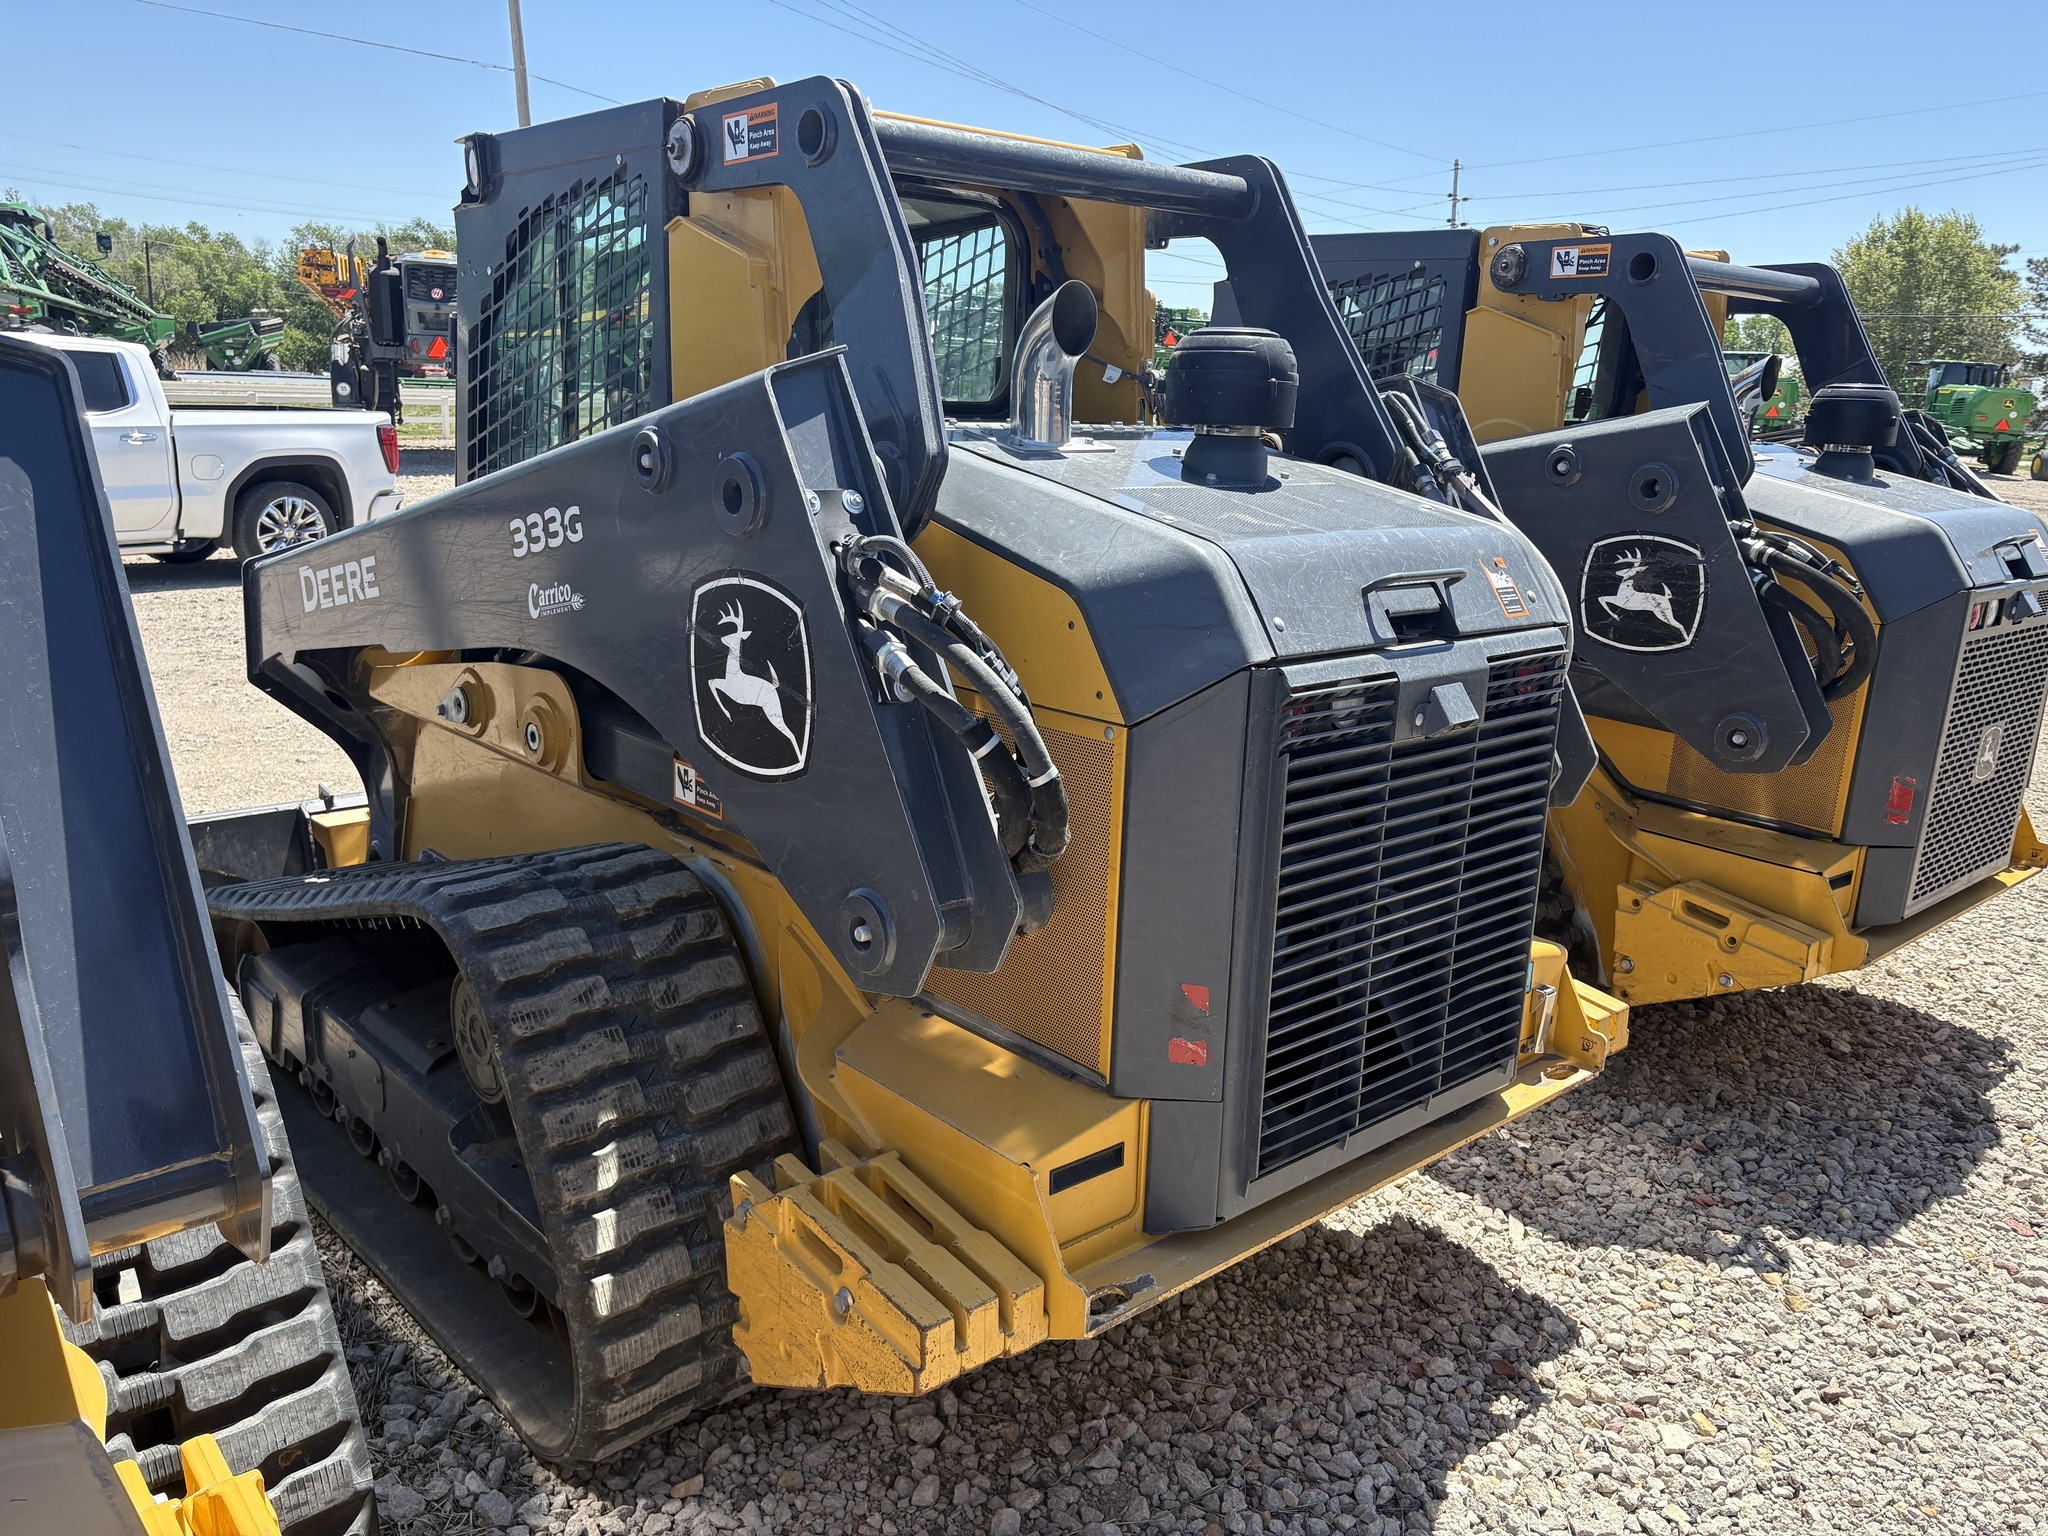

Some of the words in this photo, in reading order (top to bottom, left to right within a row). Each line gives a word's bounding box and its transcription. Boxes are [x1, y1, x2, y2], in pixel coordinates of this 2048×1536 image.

[753, 109, 776, 120] WARNING
[749, 130, 763, 140] Pinch
[763, 128, 775, 137] Area
[760, 140, 772, 149] Away
[1585, 246, 1608, 254] WARNING
[509, 505, 584, 558] 333G
[299, 555, 380, 613] DEERE
[529, 581, 571, 619] Carrico
[540, 606, 571, 617] IMPLEMENT
[696, 786, 709, 797] Pinch
[696, 795, 706, 805] Keep
[706, 800, 716, 809] Away
